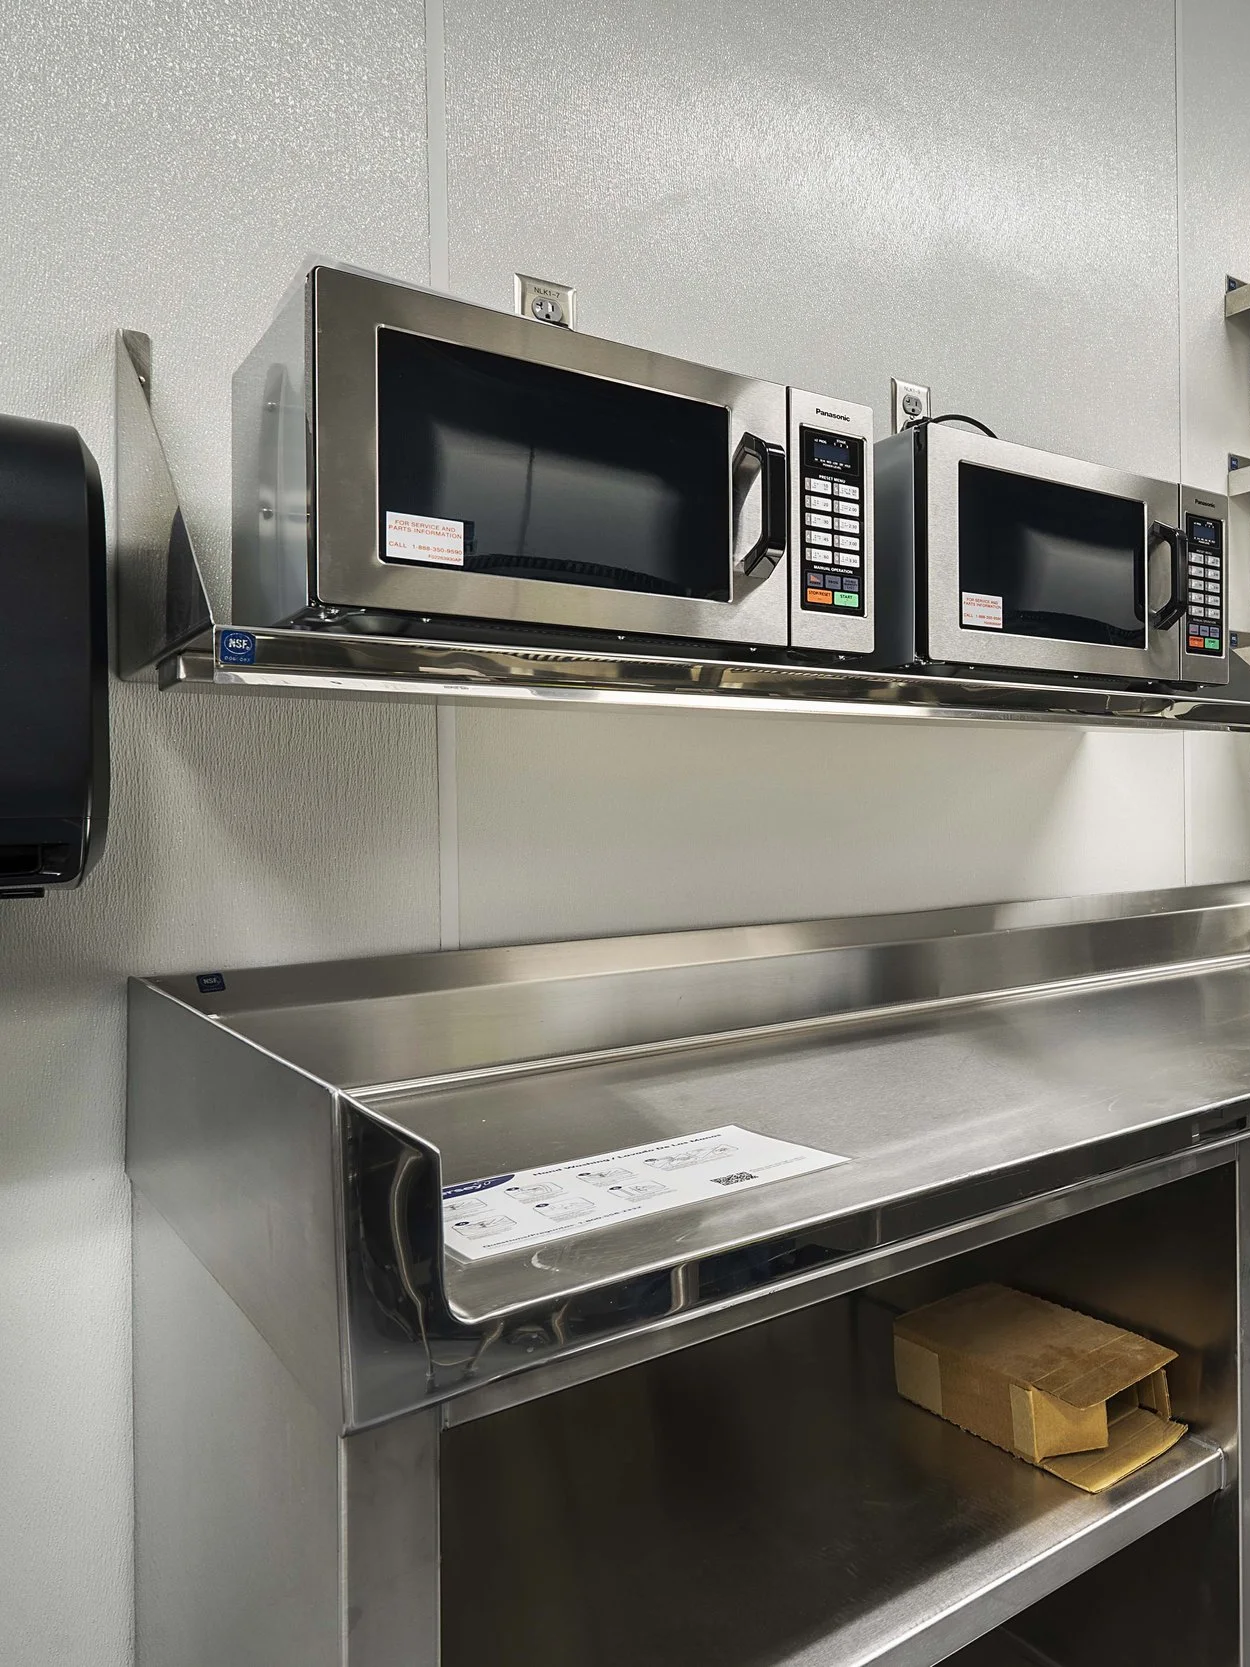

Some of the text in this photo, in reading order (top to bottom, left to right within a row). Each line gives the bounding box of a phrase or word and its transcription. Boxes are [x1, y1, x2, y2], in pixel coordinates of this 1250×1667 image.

[534, 286, 560, 298] NLK1-7
[816, 408, 850, 422] Panasonic
[411, 521, 440, 530] SERVICE
[414, 528, 462, 539] INFORMATION
[229, 638, 248, 649] NSF
[533, 1168, 562, 1177] Hand
[564, 1158, 610, 1170] Washing
